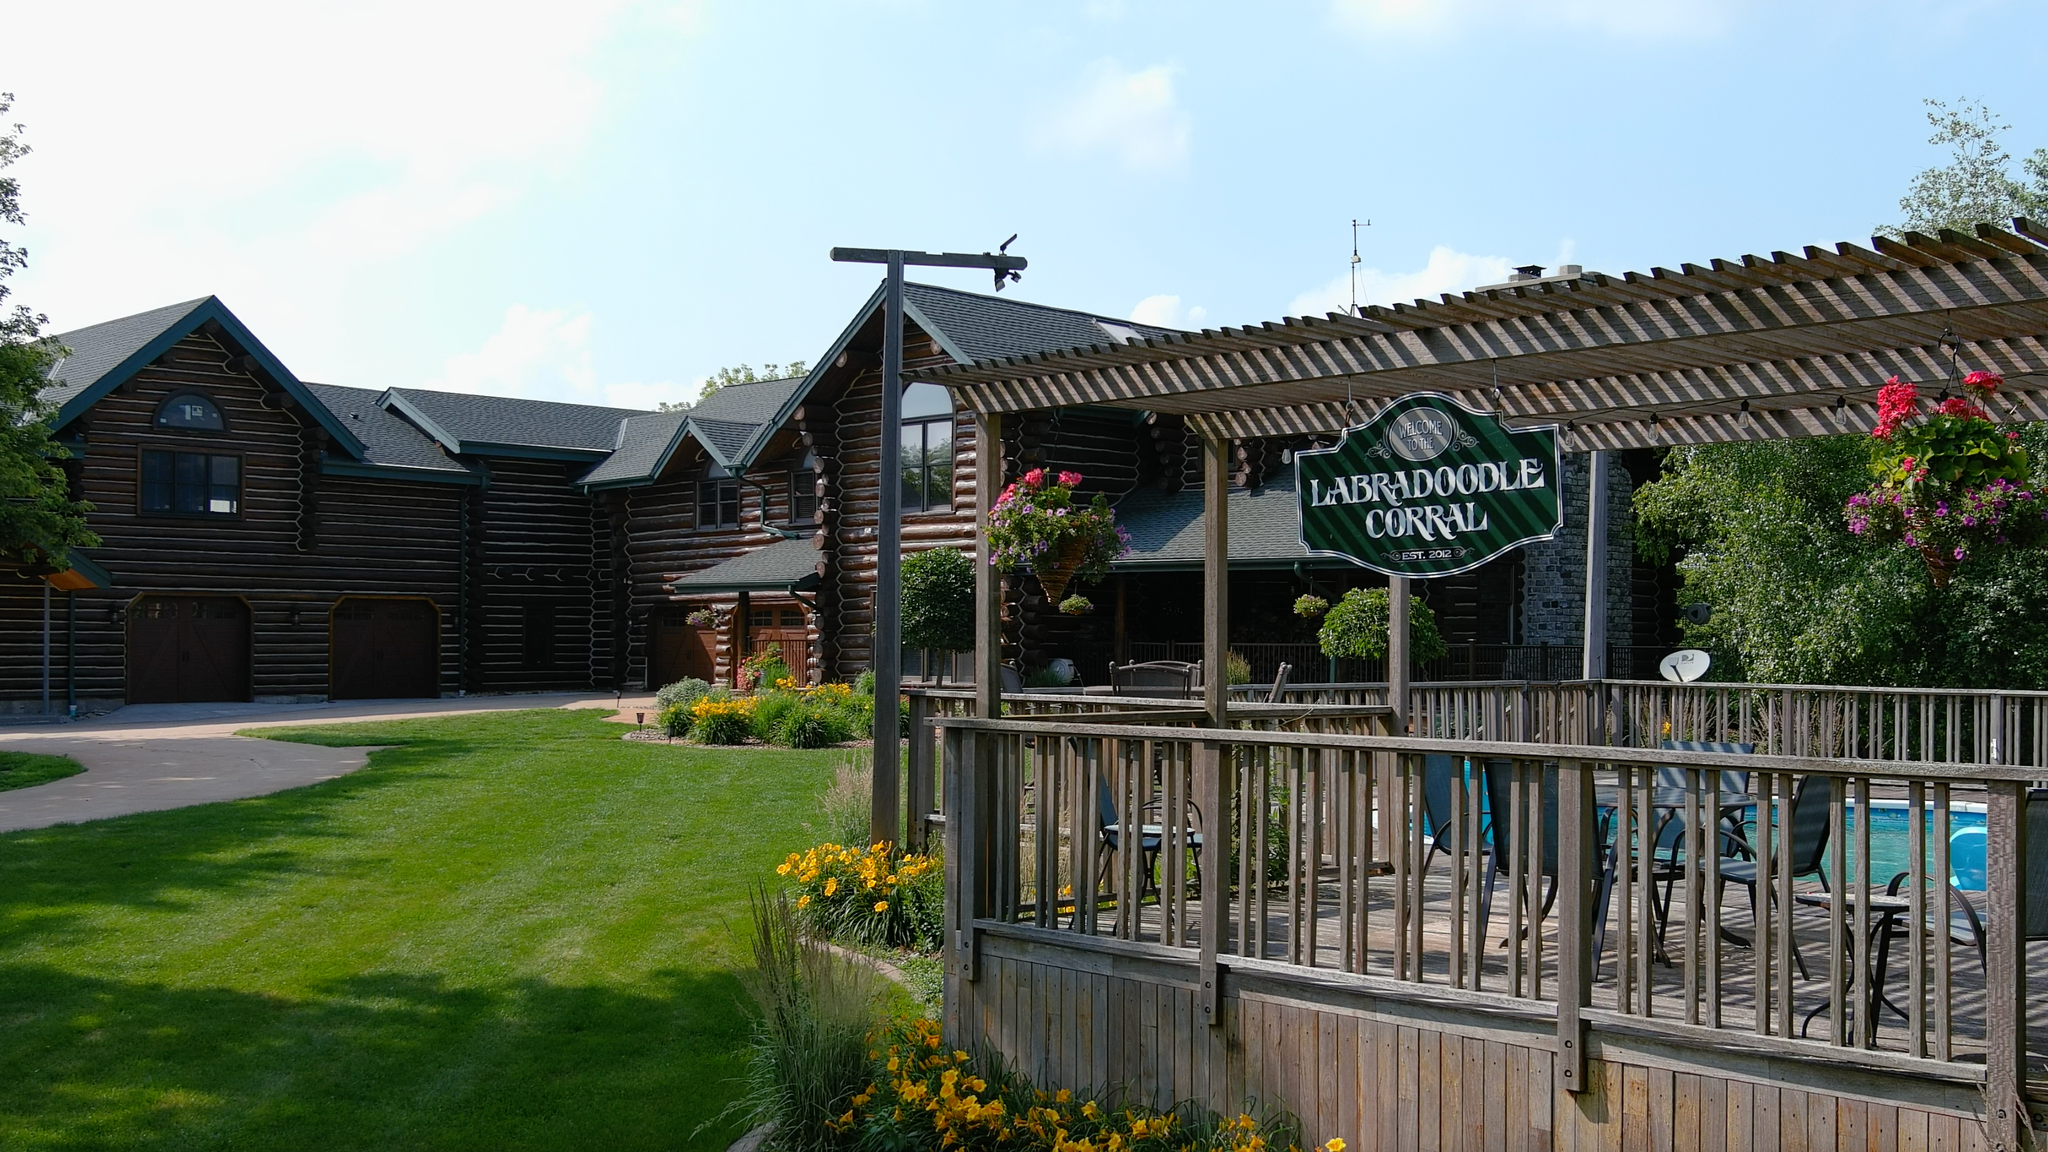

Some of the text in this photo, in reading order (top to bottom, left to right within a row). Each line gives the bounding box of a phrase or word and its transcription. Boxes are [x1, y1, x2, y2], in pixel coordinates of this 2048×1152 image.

[1399, 420, 1443, 439] WELCOME
[1408, 437, 1434, 451] TO THE
[1310, 458, 1545, 507] LABRADOODLE
[1365, 502, 1488, 541] CORRAL
[1402, 549, 1452, 560] EST. 2012
